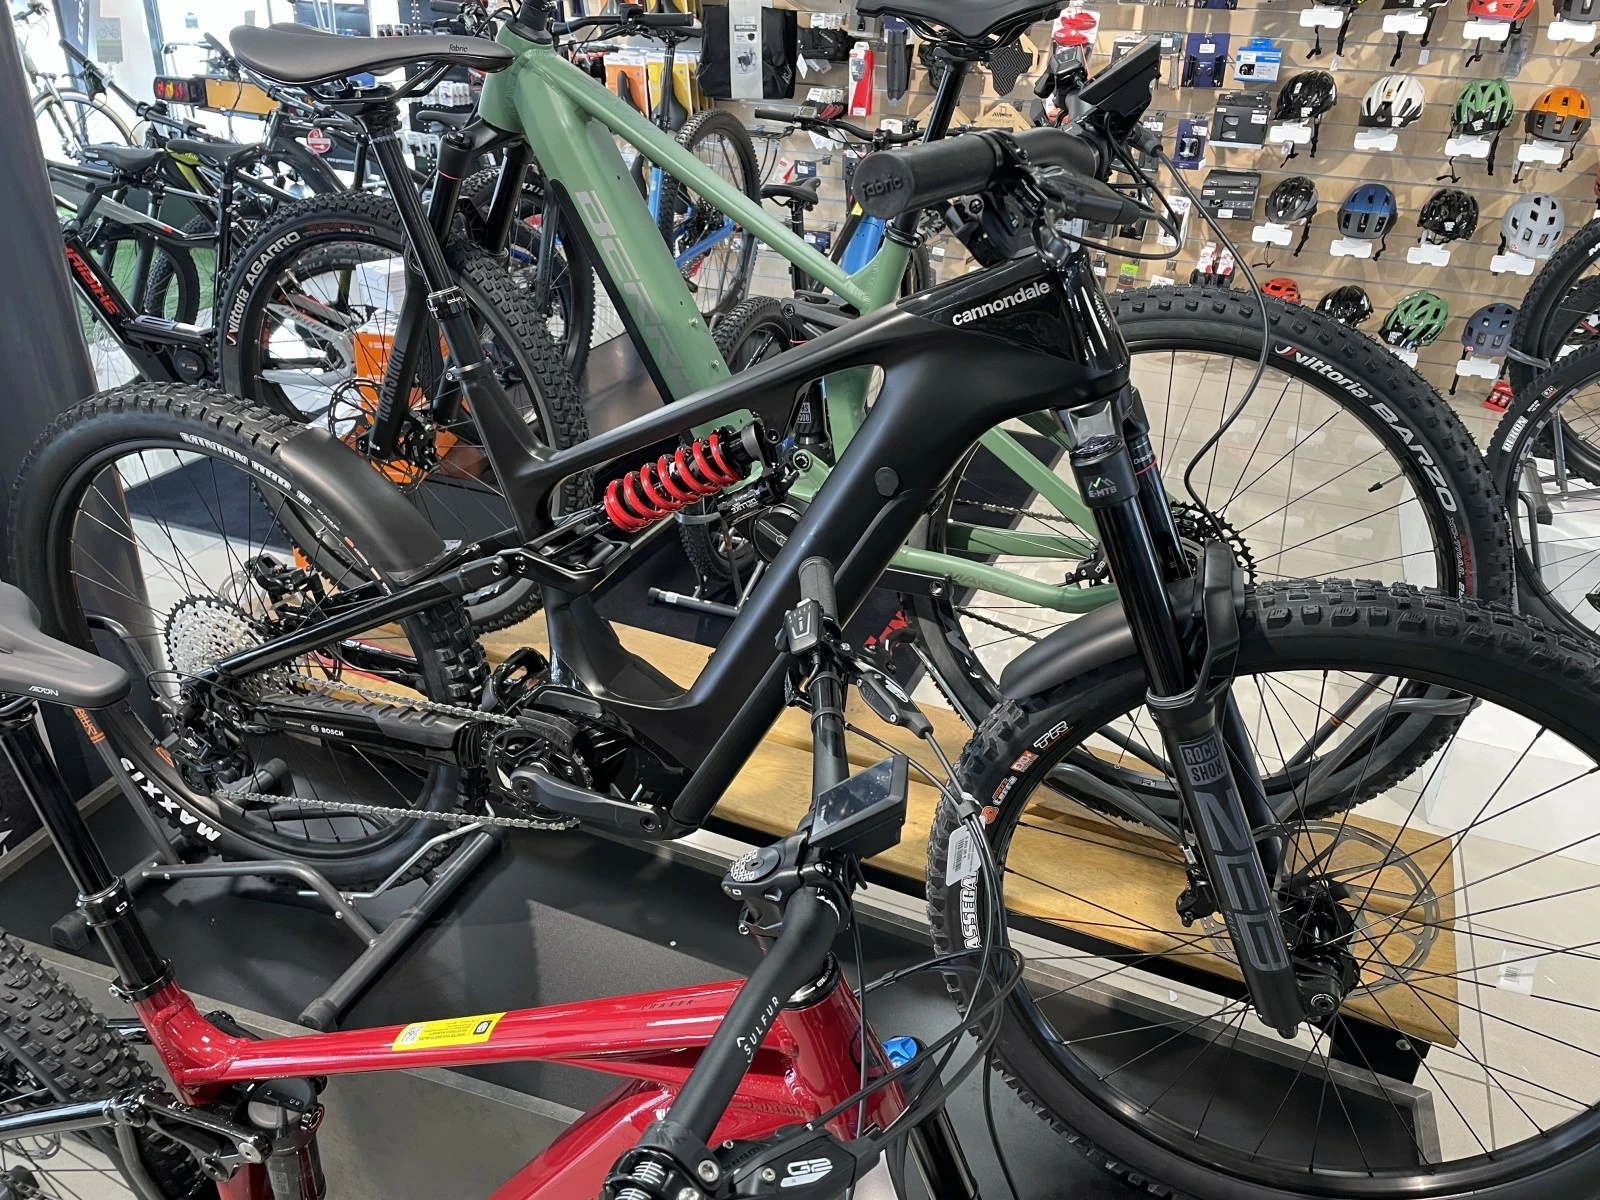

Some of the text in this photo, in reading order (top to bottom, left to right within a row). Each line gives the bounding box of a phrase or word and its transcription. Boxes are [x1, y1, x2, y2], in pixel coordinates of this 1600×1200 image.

[449, 44, 468, 53] fabric
[521, 182, 544, 196] XXIS
[861, 173, 903, 205] fabric
[227, 231, 301, 335] vittoria AGARRO
[952, 281, 1051, 327] cannondale
[1294, 351, 1458, 512] vittoria BARZO
[321, 727, 344, 737] BOSCH
[1033, 720, 1069, 749] TR
[1184, 739, 1219, 766] ROCK
[1191, 759, 1224, 783] SHOX
[120, 757, 222, 842] MAXXIS
[1193, 787, 1291, 972] ZEB
[1224, 909, 1242, 943] SELECT
[640, 999, 694, 1011] CHASER
[744, 996, 781, 1056] SULFUR
[787, 1157, 833, 1176] G2
